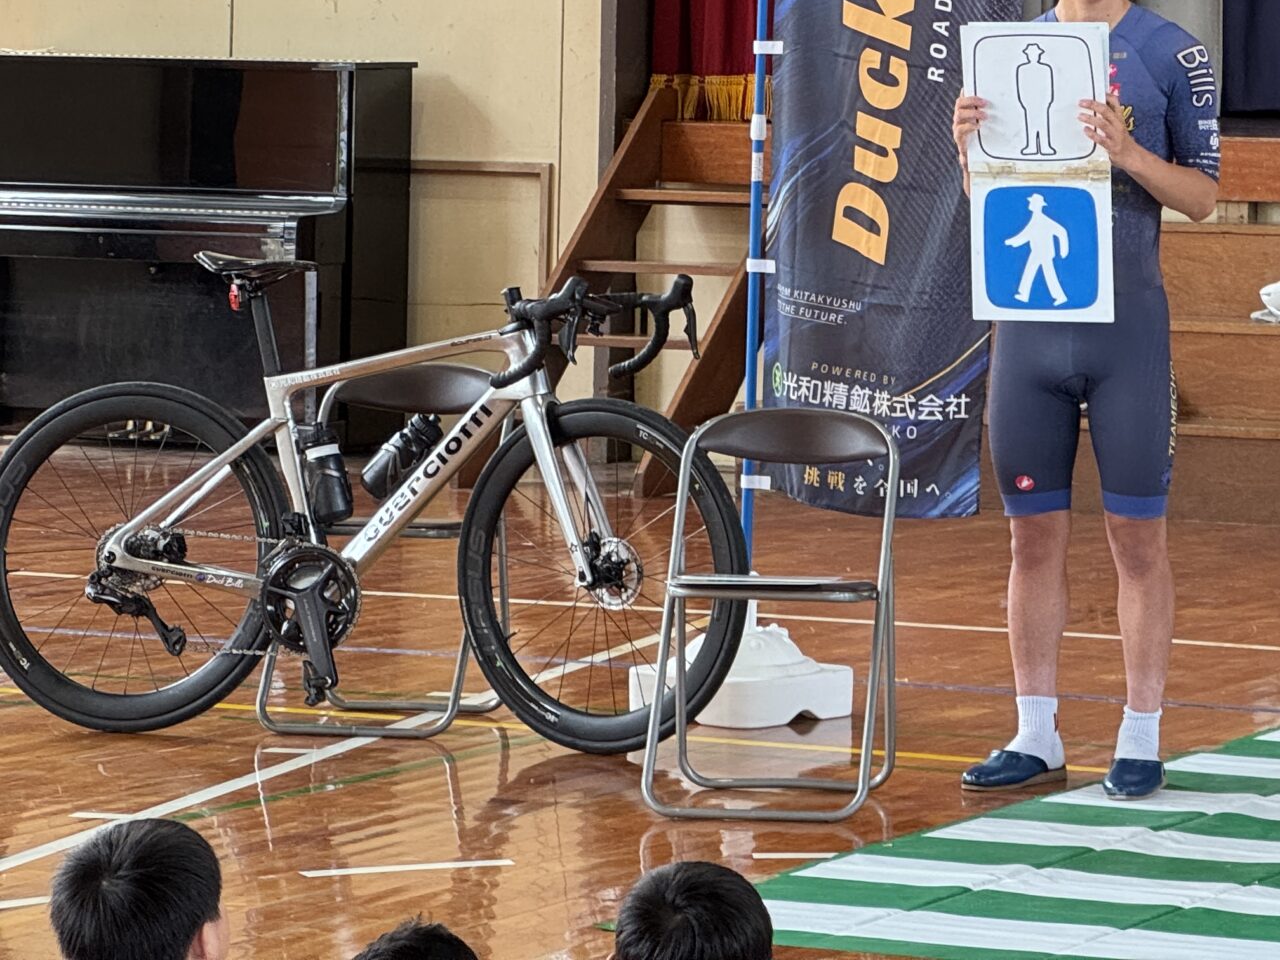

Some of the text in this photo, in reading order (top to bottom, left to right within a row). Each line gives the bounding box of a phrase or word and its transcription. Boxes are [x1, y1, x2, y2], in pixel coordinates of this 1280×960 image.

[1176, 45, 1216, 107] Bills
[793, 289, 862, 312] KITAKYUSHU
[811, 361, 897, 386] POWERED BY
[782, 370, 972, 422] 光和精鉱株式会社
